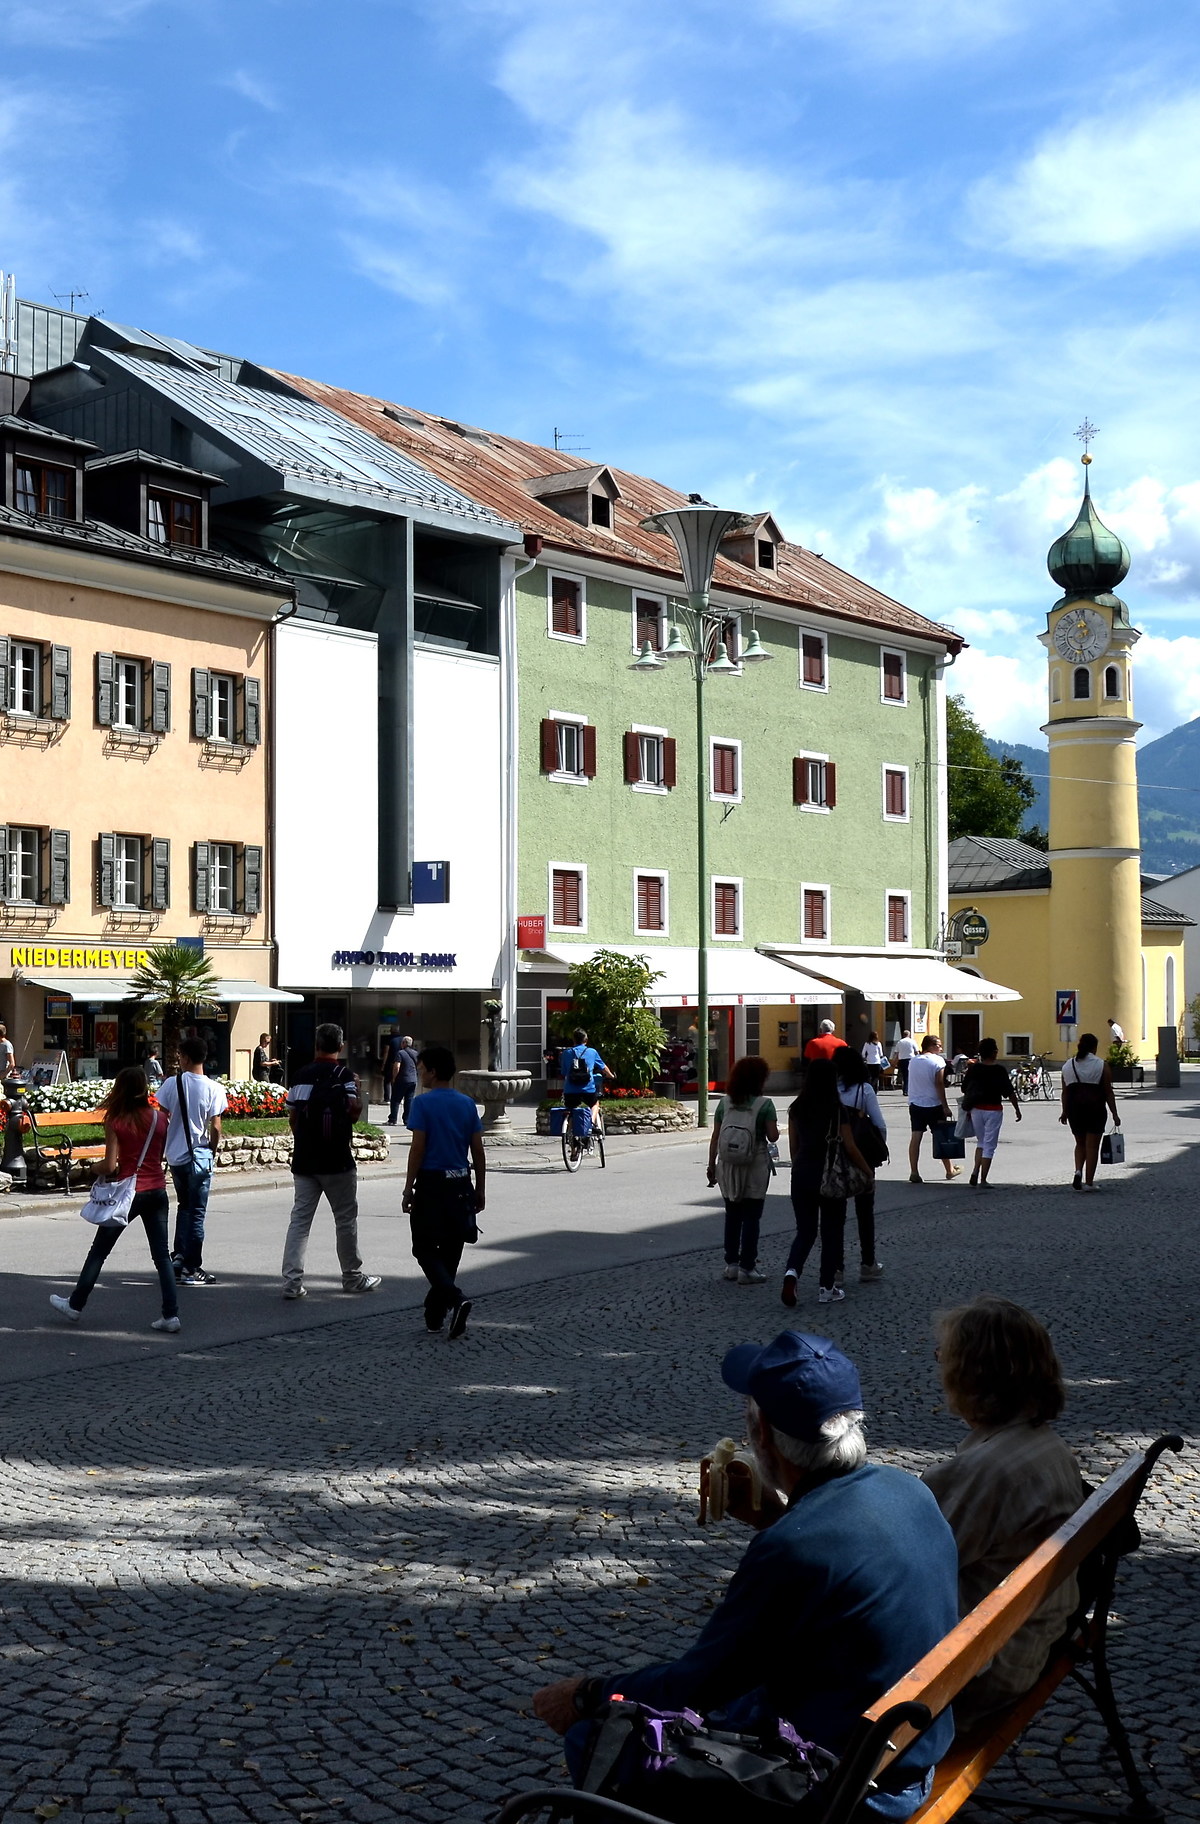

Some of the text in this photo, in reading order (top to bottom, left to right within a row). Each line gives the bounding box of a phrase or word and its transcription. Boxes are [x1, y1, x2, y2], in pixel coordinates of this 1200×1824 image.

[518, 919, 543, 928] HUBER
[334, 950, 457, 966] HYPO TIROL BANK
[96, 1042, 117, 1050] SALE
